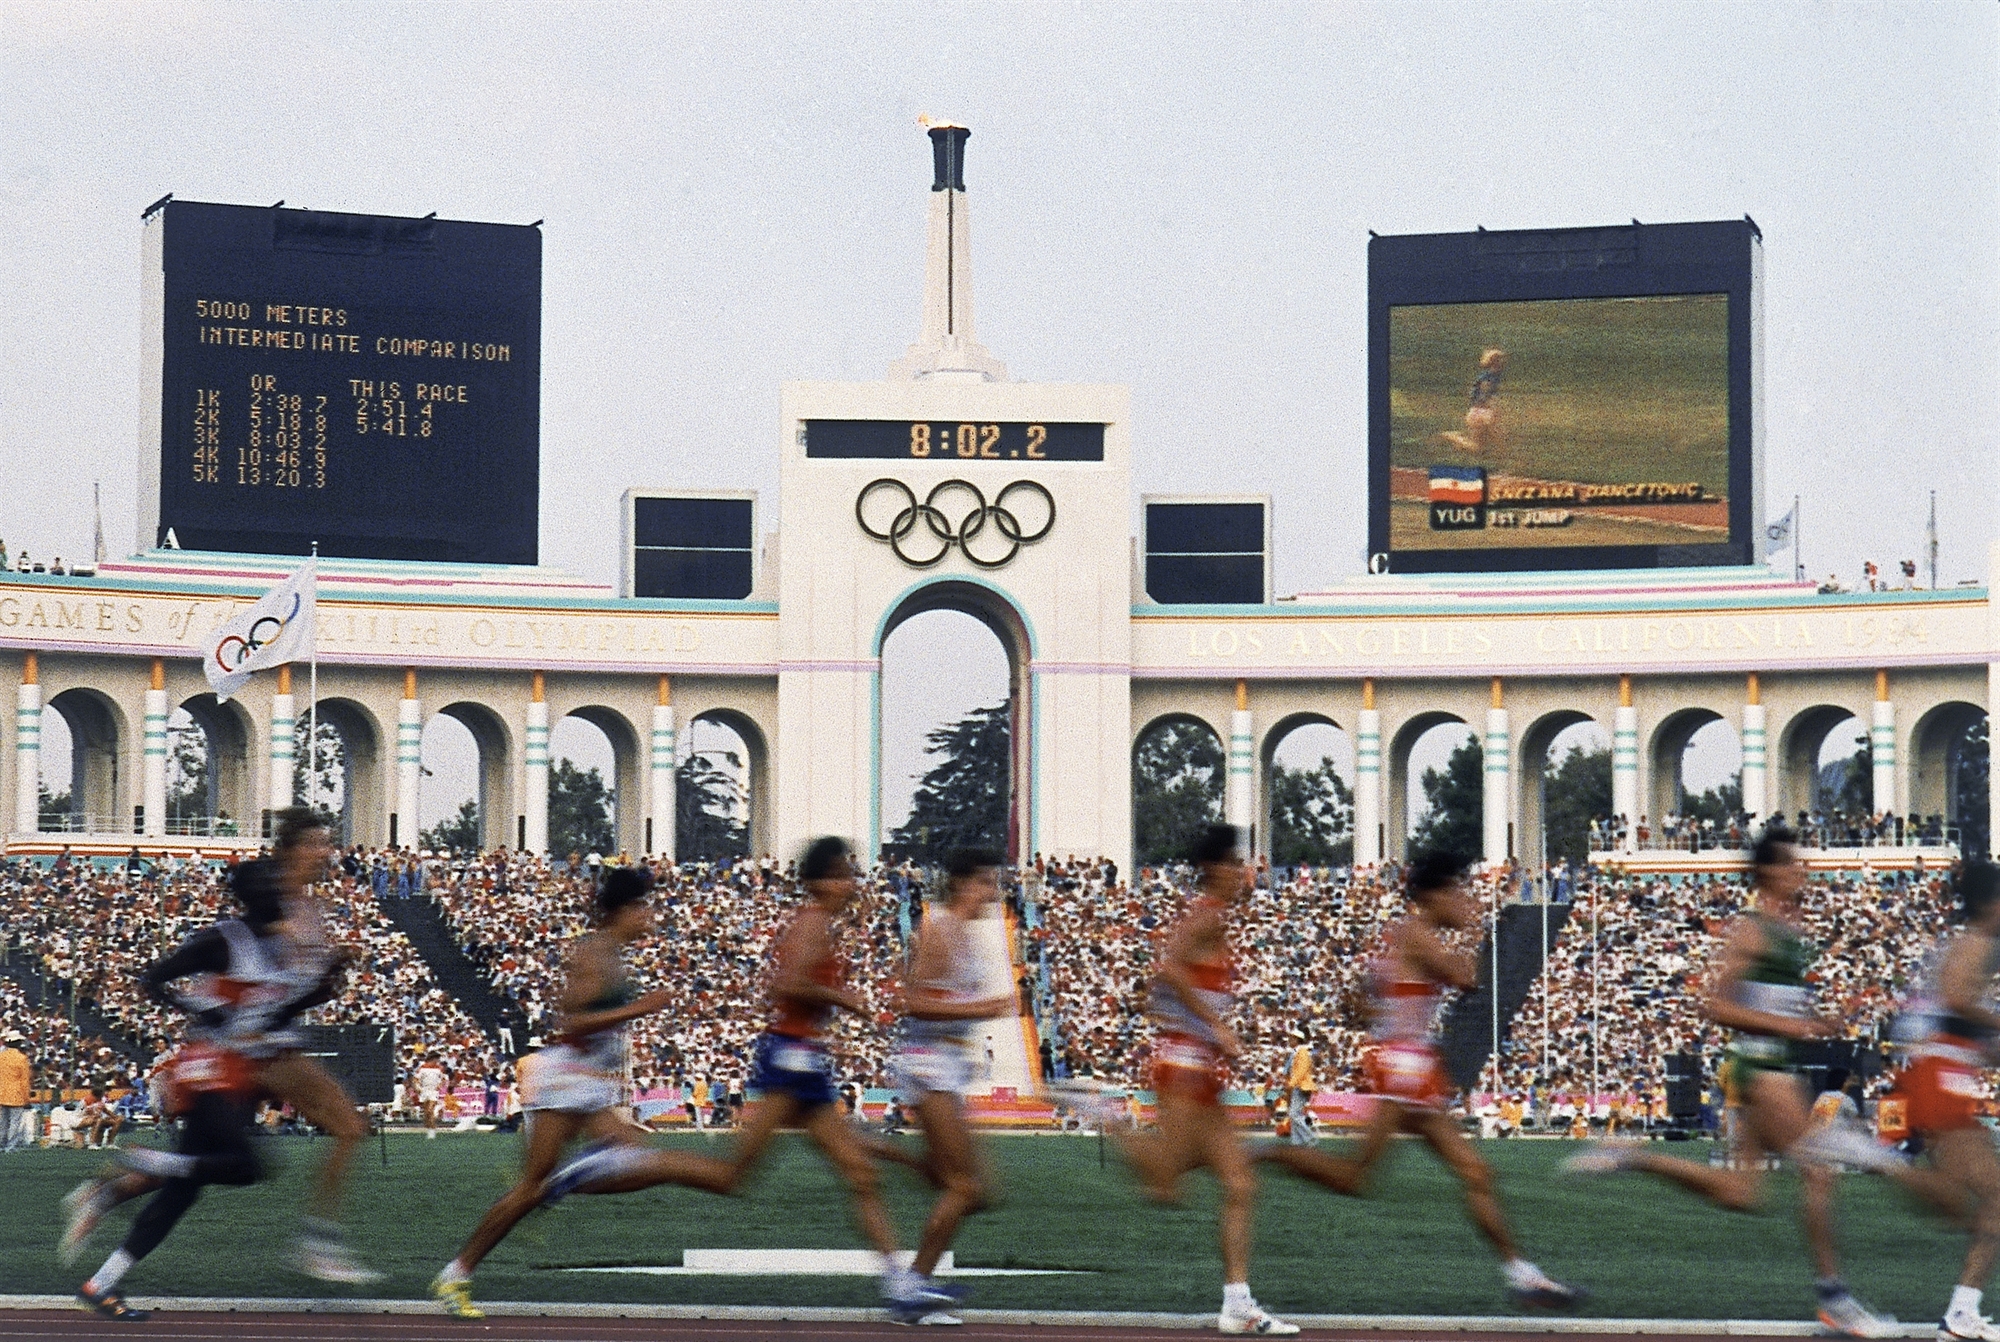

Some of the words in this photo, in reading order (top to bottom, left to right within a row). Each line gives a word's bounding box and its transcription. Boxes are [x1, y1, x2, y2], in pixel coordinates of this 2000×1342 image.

[195, 299, 250, 320] 5000
[266, 304, 348, 327] METERS
[200, 326, 360, 353] INTERMEDIATE
[376, 336, 510, 362] COMPARISON
[196, 389, 221, 407] 1K
[251, 374, 277, 392] OR
[349, 379, 400, 399] THIS
[416, 383, 469, 403] RACE
[194, 407, 220, 426] 2K
[194, 426, 219, 445] 3K
[910, 423, 1047, 460] 8:02.2
[193, 445, 219, 464] 4K
[193, 464, 219, 483] 5K
[1436, 507, 1476, 523] YUG
[0, 597, 144, 634] GAMES
[168, 602, 201, 641] of
[469, 618, 702, 652] OLYMPIAD
[1187, 628, 1262, 657] LOS
[1290, 627, 1493, 656] ANGELES
[1535, 620, 1815, 653] CALIFORNIA
[1844, 616, 1930, 646] 1984
